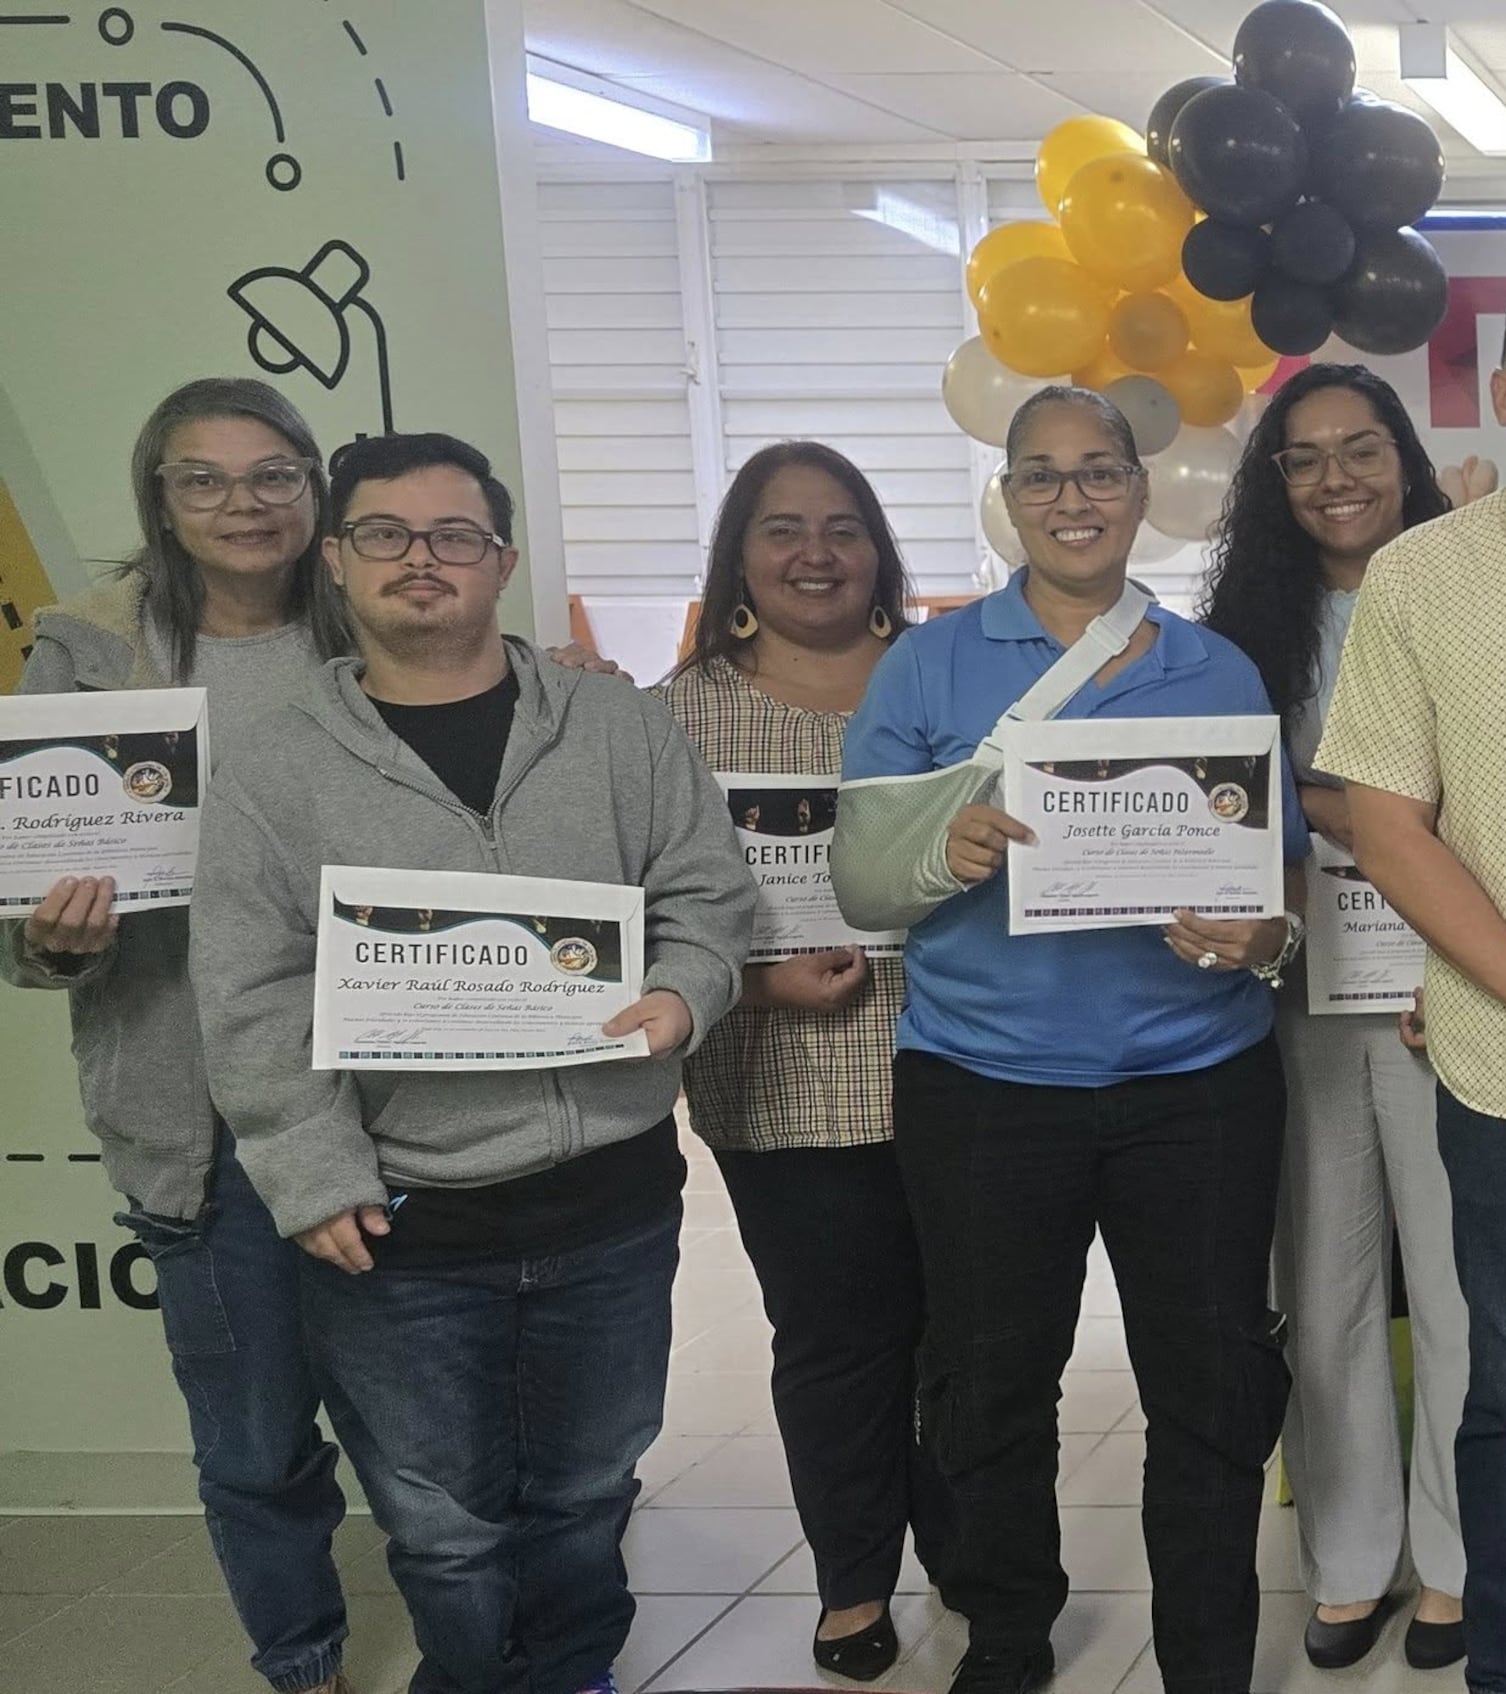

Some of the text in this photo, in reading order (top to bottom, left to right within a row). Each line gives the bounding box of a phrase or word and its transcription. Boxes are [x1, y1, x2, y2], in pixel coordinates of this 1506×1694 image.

[0, 81, 210, 139] ENTO
[0, 773, 99, 799] FICADO
[1042, 791, 1190, 814] CERTIFICADO
[120, 810, 186, 825] Rivera
[1063, 823, 1221, 839] Josette García Ponce
[759, 872, 808, 888] Janice
[1343, 920, 1405, 934] Mariana
[356, 941, 528, 967] CERTIFICADO
[337, 977, 400, 991] Xavier
[406, 977, 449, 992] Raúl
[454, 979, 514, 993] Rosado
